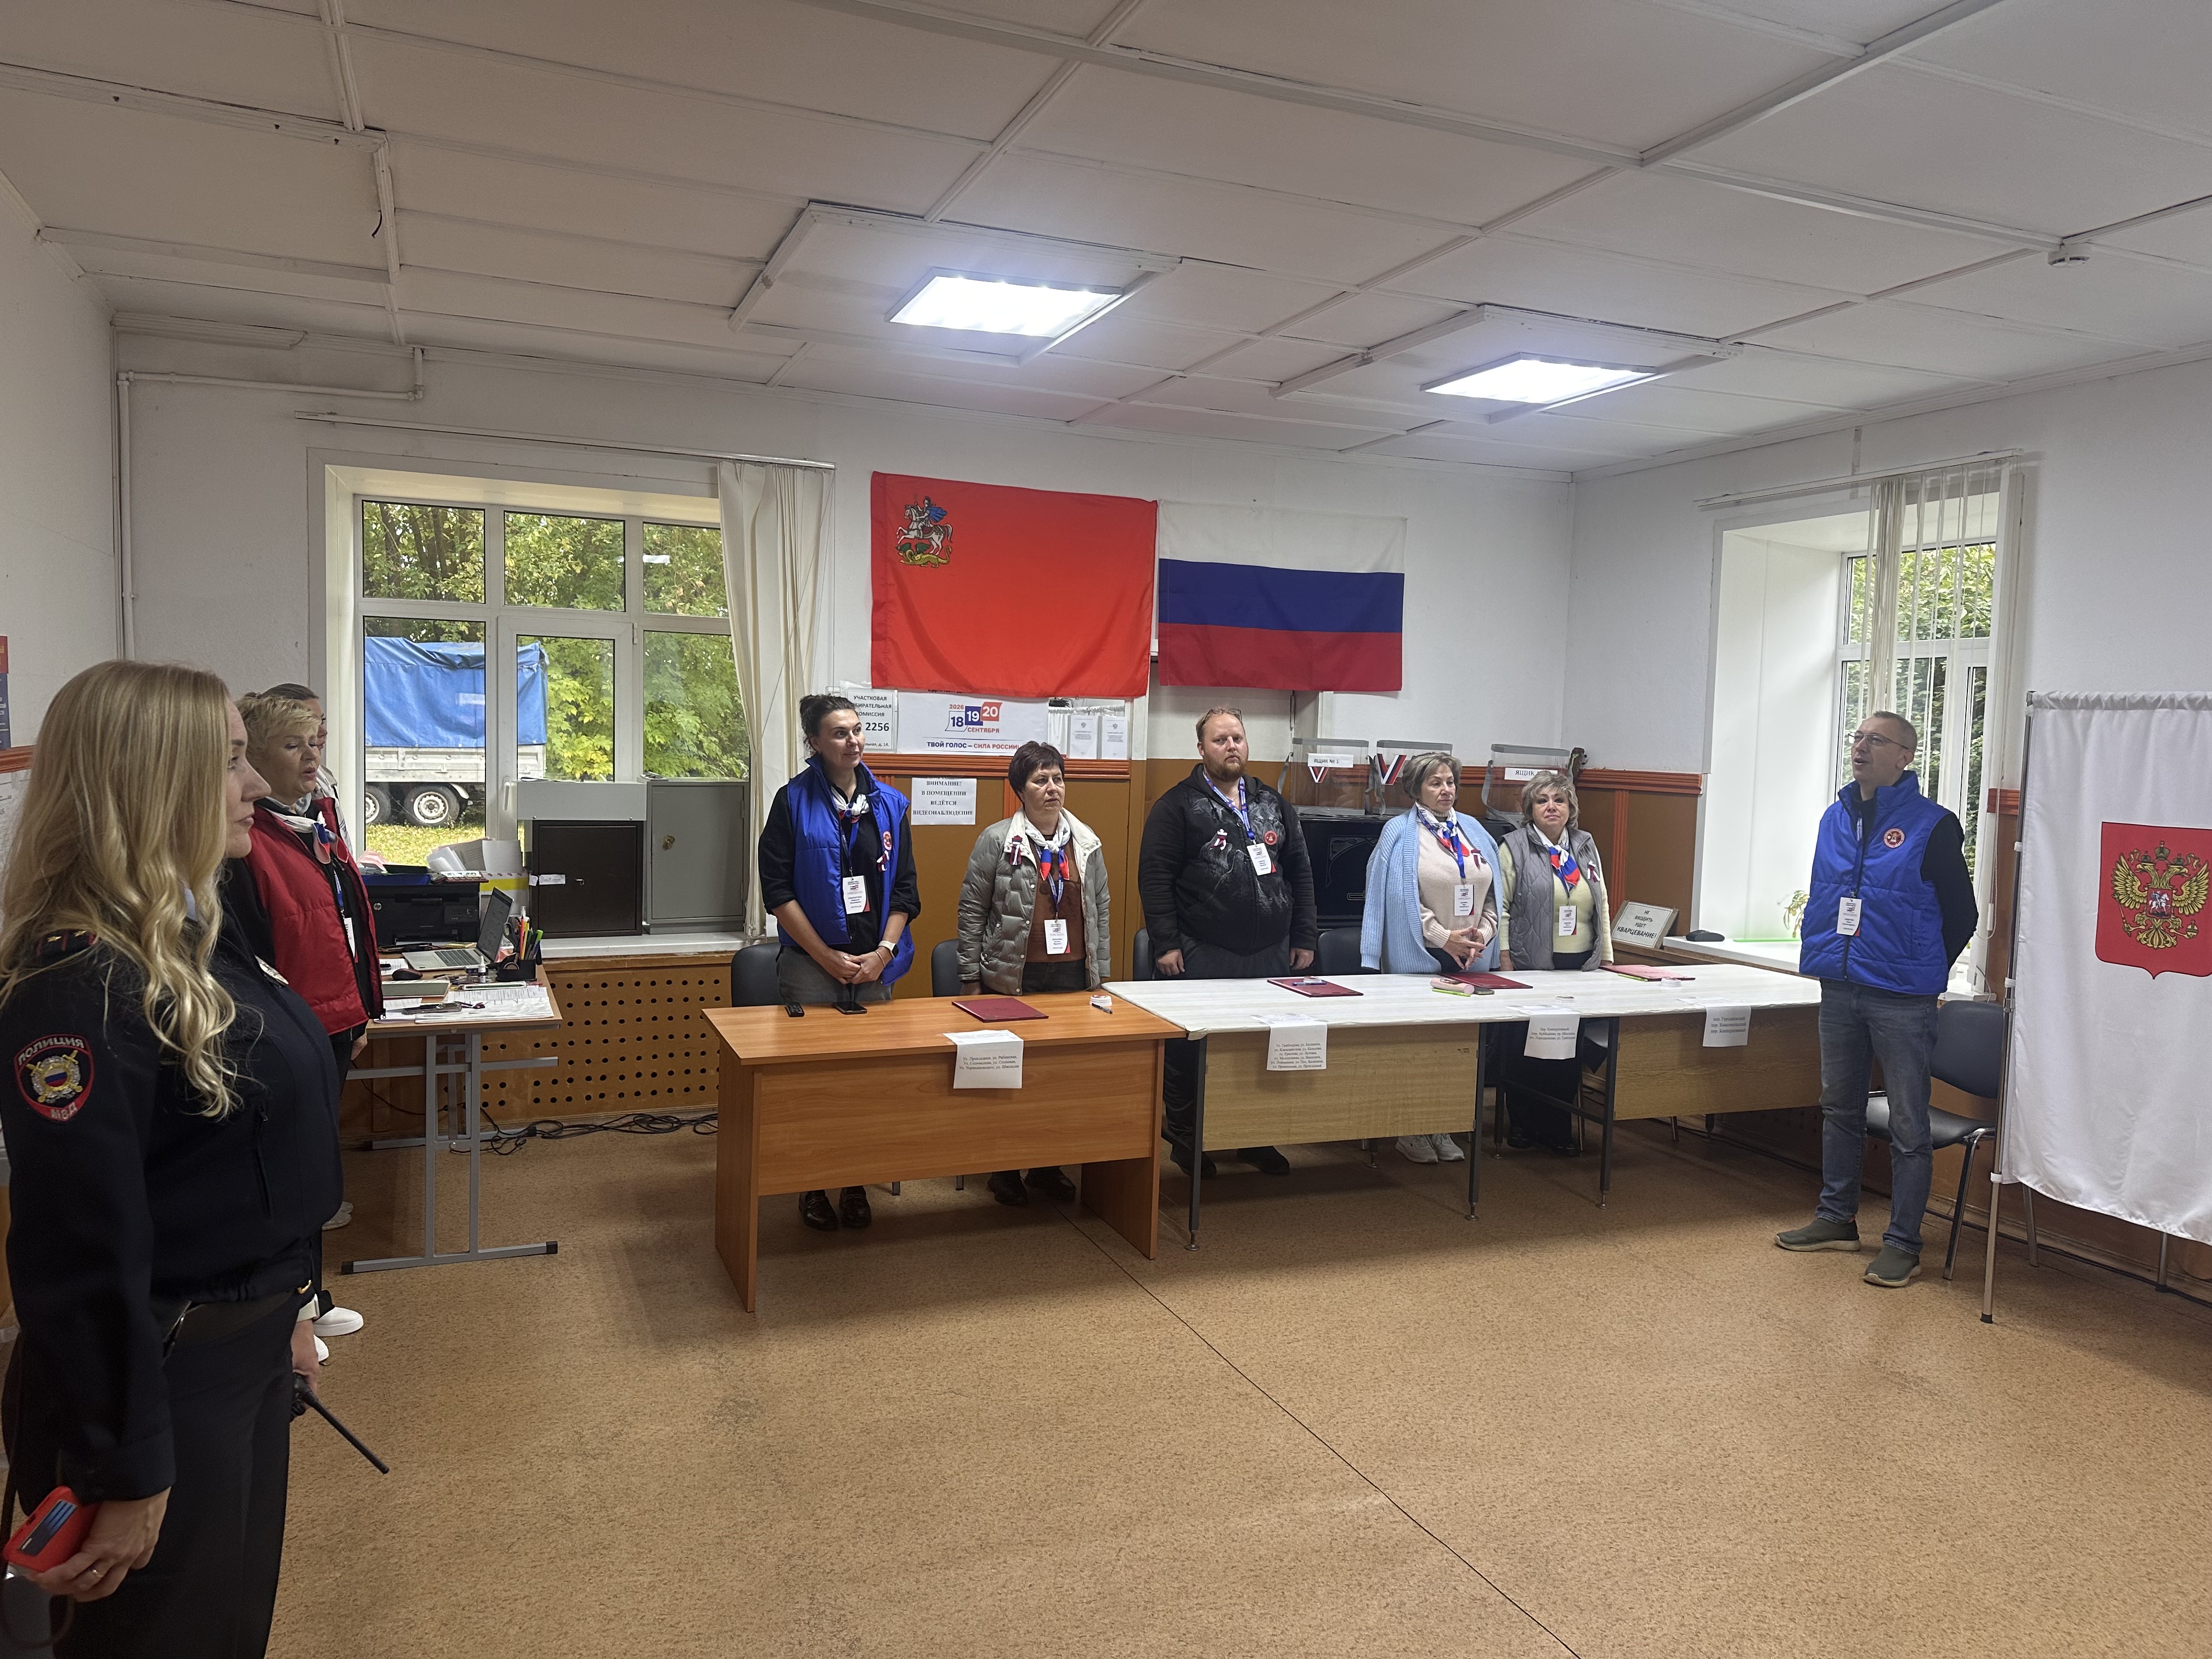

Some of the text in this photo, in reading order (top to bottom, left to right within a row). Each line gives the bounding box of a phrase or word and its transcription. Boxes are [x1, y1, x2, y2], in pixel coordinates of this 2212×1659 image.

[951, 706, 998, 727] 18 19 20
[865, 723, 889, 731] 2256
[1617, 926, 1657, 939] КВАРЦЕВАНИЕ!
[18, 1037, 84, 1066] ПОЛИЦИЯ
[50, 1102, 78, 1120] МВД
